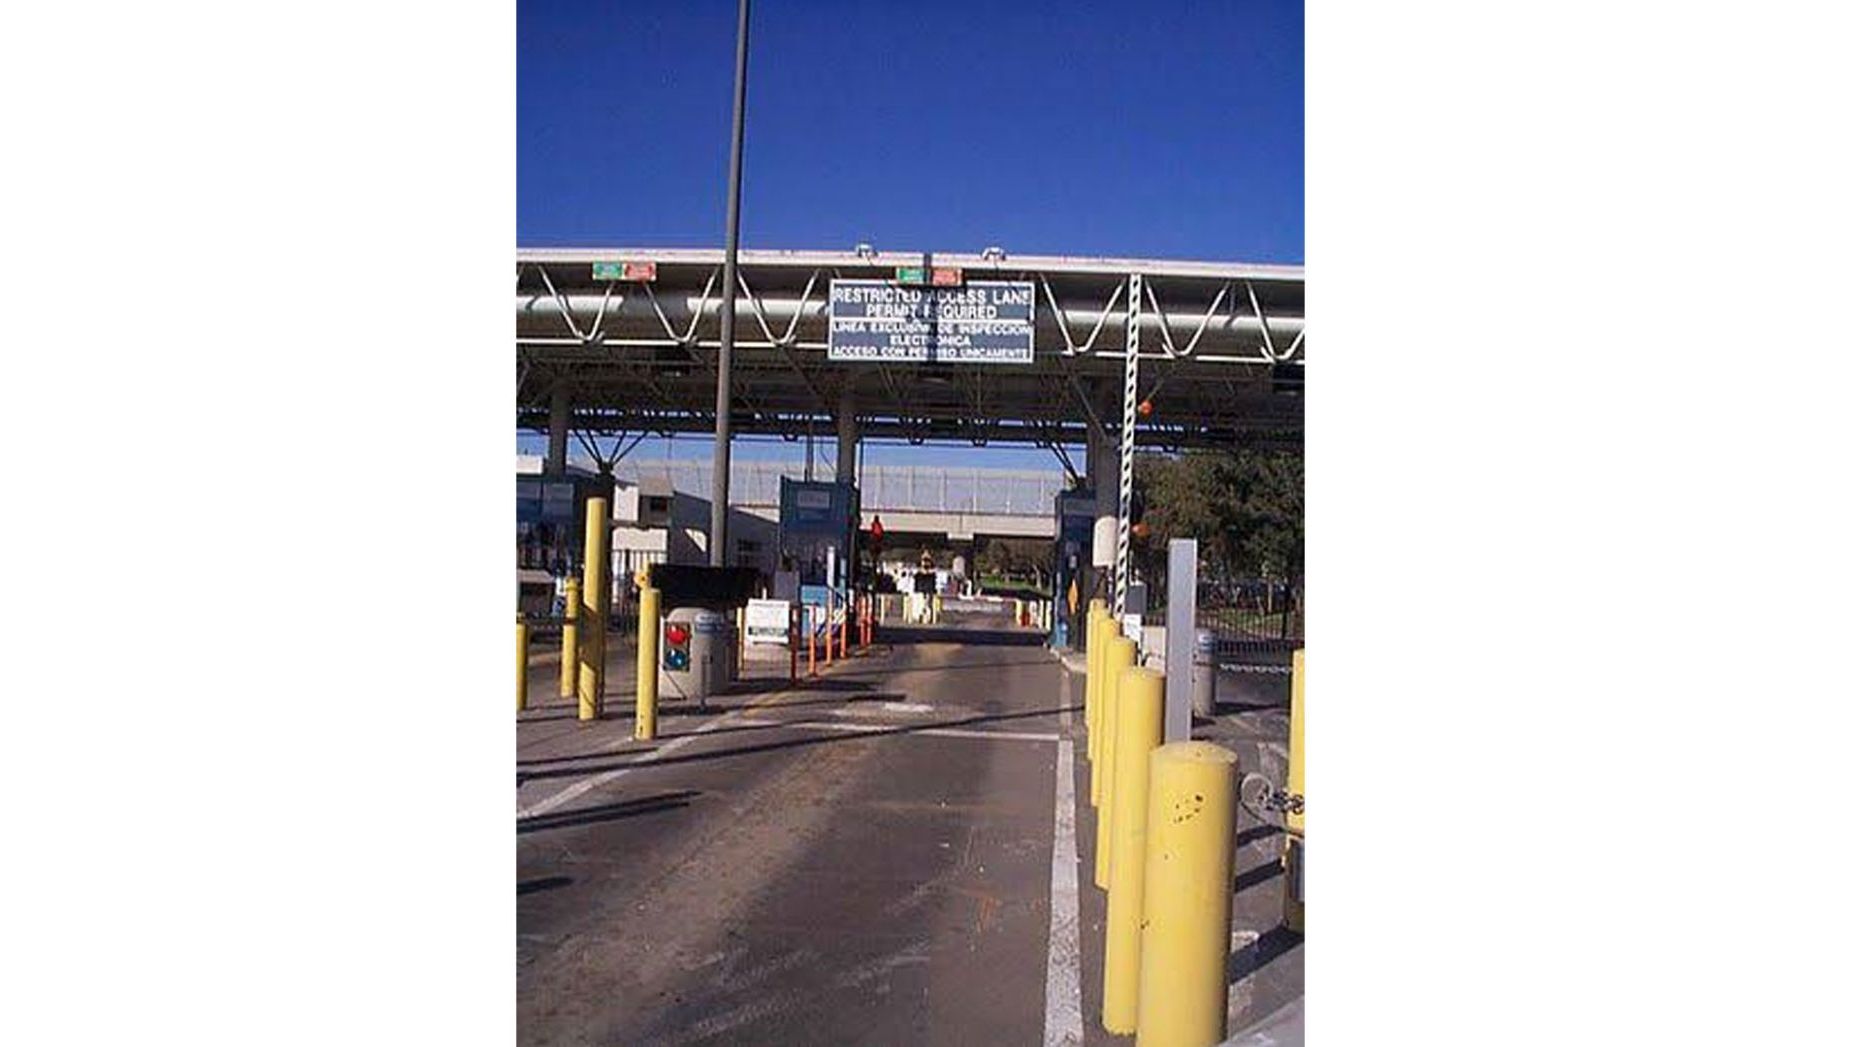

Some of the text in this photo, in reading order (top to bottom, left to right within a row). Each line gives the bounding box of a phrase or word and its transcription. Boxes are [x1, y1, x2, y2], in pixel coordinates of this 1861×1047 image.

[833, 287, 1032, 305] RESTRICTED ACCESS LANE
[866, 303, 997, 319] PERMIT RQUIRED
[889, 334, 971, 346] ELECTONICA
[881, 346, 906, 357] CON
[908, 346, 957, 358] PERISO
